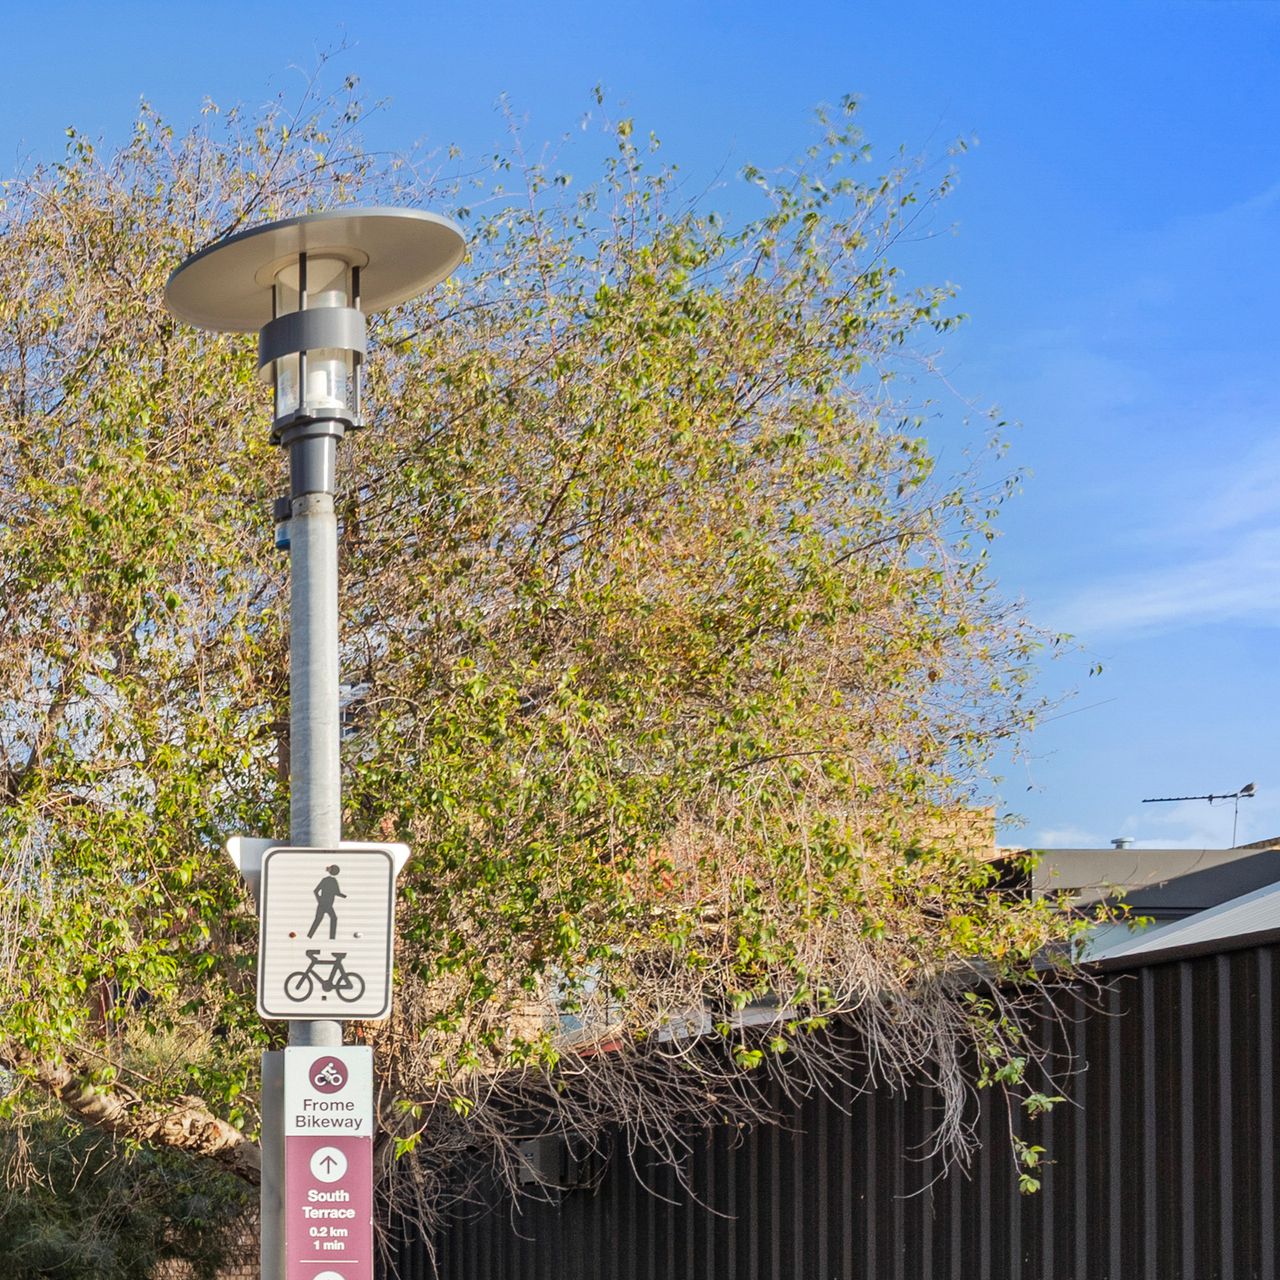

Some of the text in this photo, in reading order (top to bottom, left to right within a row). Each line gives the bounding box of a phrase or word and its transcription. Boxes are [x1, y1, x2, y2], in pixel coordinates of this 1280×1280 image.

[303, 1098, 355, 1112] Frome
[295, 1115, 364, 1131] Bikeway
[307, 1189, 350, 1203] South
[301, 1206, 356, 1219] Terrace
[309, 1226, 349, 1237] 0.2 km
[313, 1240, 345, 1250] 1 min
